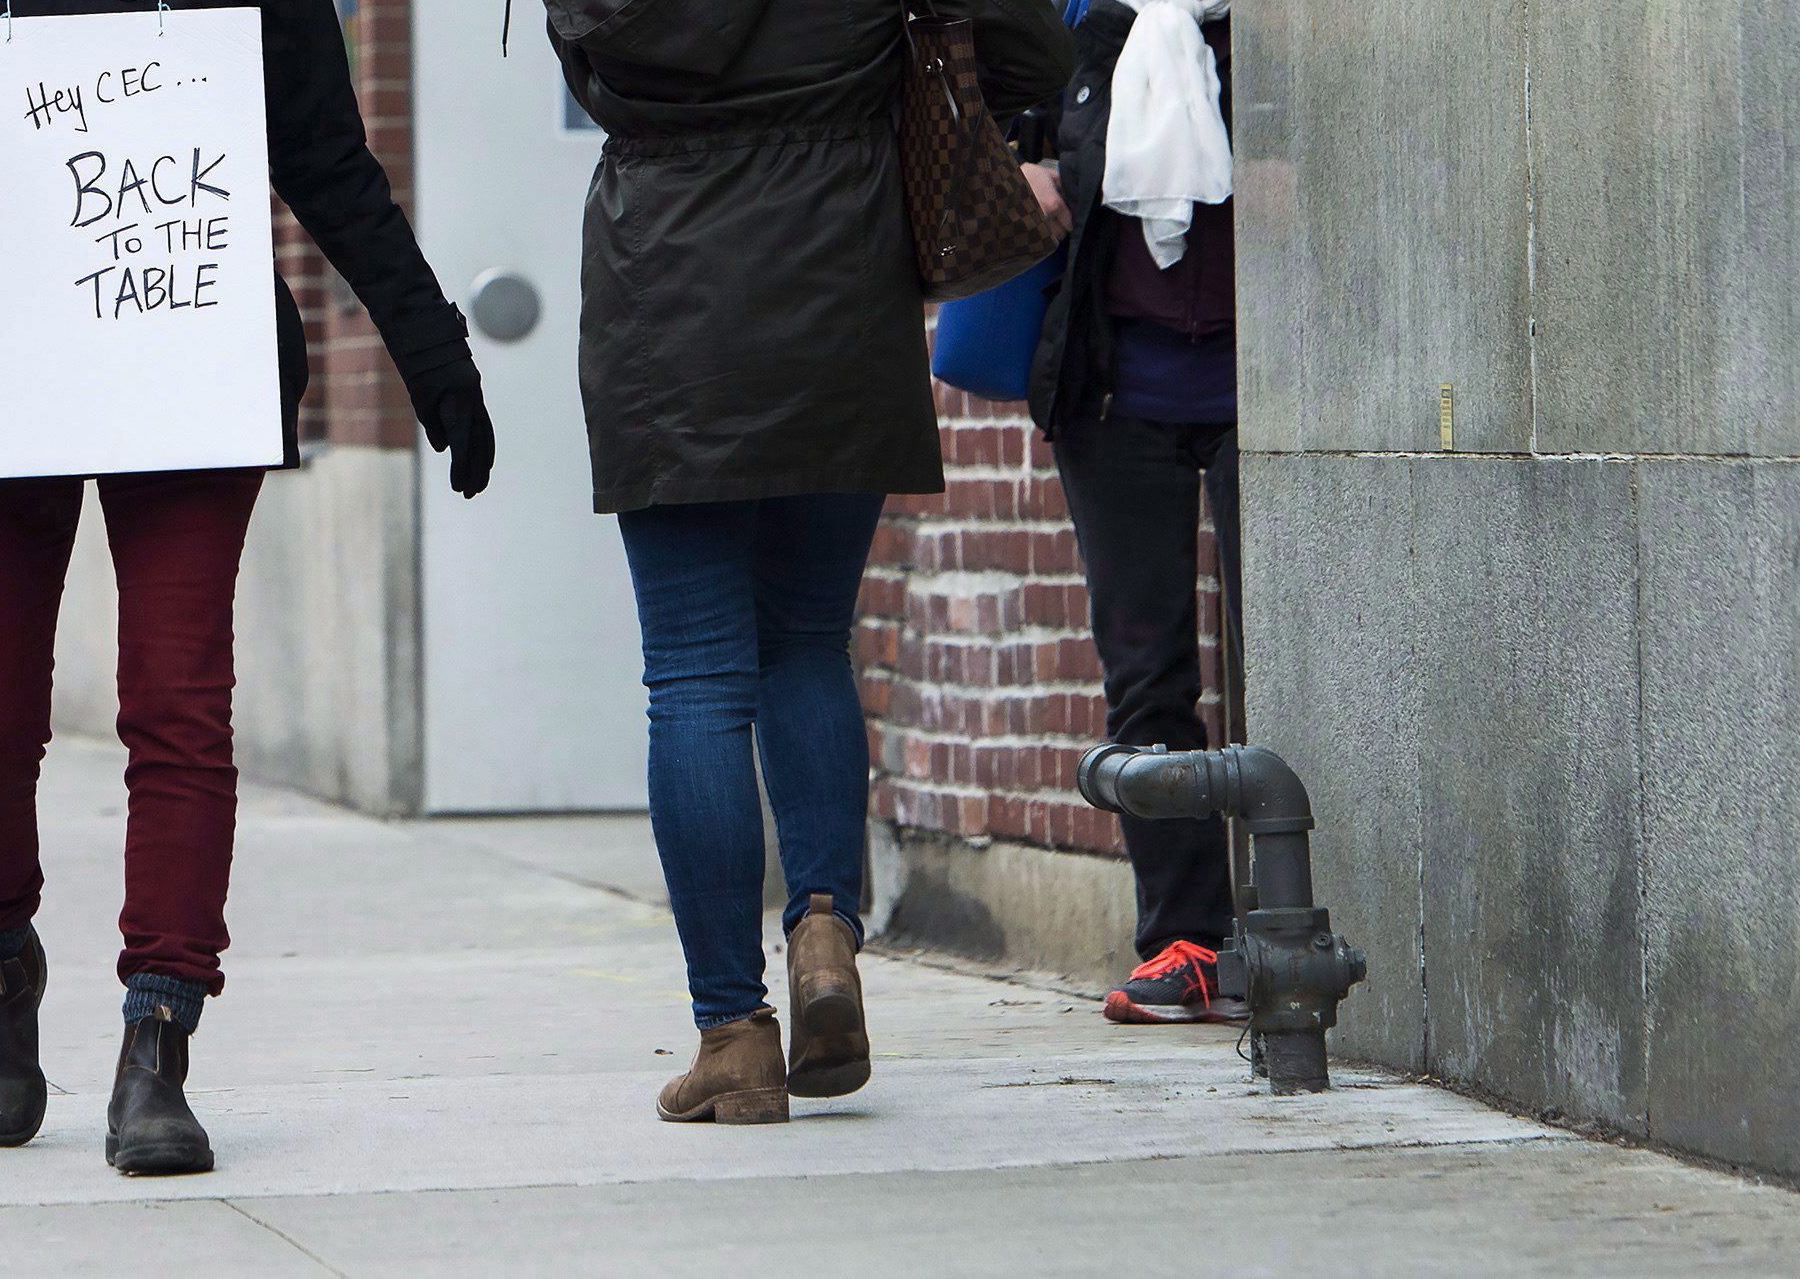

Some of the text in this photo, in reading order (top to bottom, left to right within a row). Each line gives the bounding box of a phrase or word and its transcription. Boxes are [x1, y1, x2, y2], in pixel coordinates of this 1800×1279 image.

[24, 82, 88, 132] Hey
[65, 147, 230, 227] BACK
[154, 217, 228, 253] THE
[74, 263, 218, 320] TABLE
